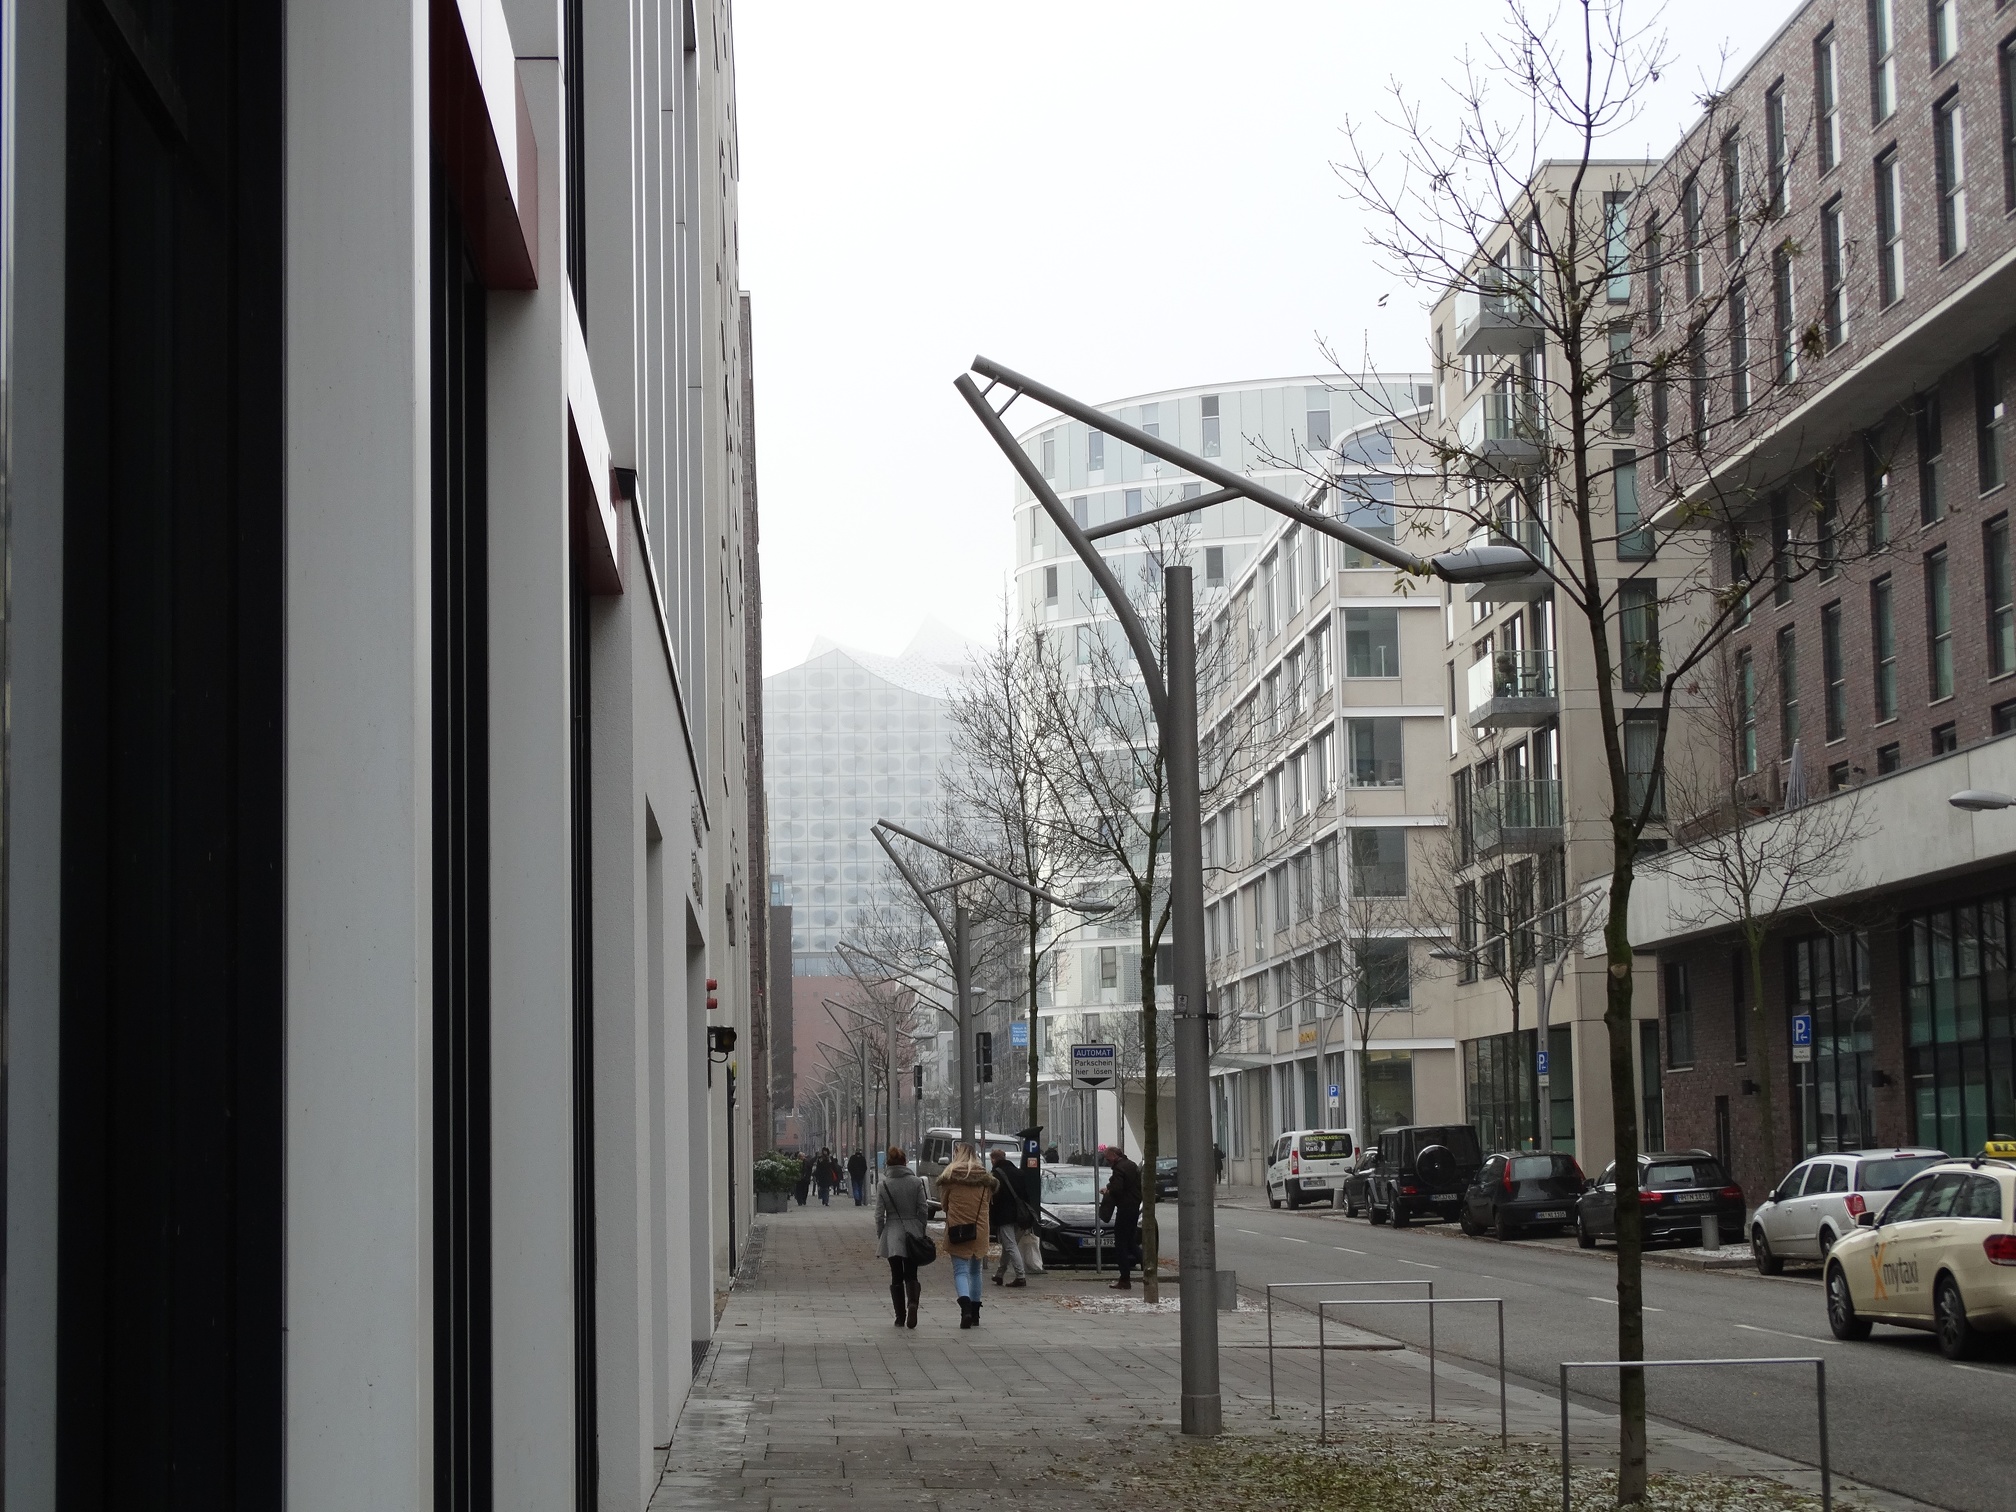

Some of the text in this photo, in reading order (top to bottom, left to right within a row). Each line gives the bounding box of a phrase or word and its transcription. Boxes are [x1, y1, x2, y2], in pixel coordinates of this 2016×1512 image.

[1795, 1019, 1806, 1042] P
[1076, 1049, 1112, 1057] AUTOMAT
[1074, 1059, 1113, 1067] Parkschein
[1538, 1054, 1545, 1071] P
[1330, 1086, 1337, 1096] P
[1029, 1140, 1038, 1153] P
[1883, 1252, 1919, 1292] mytaxi
